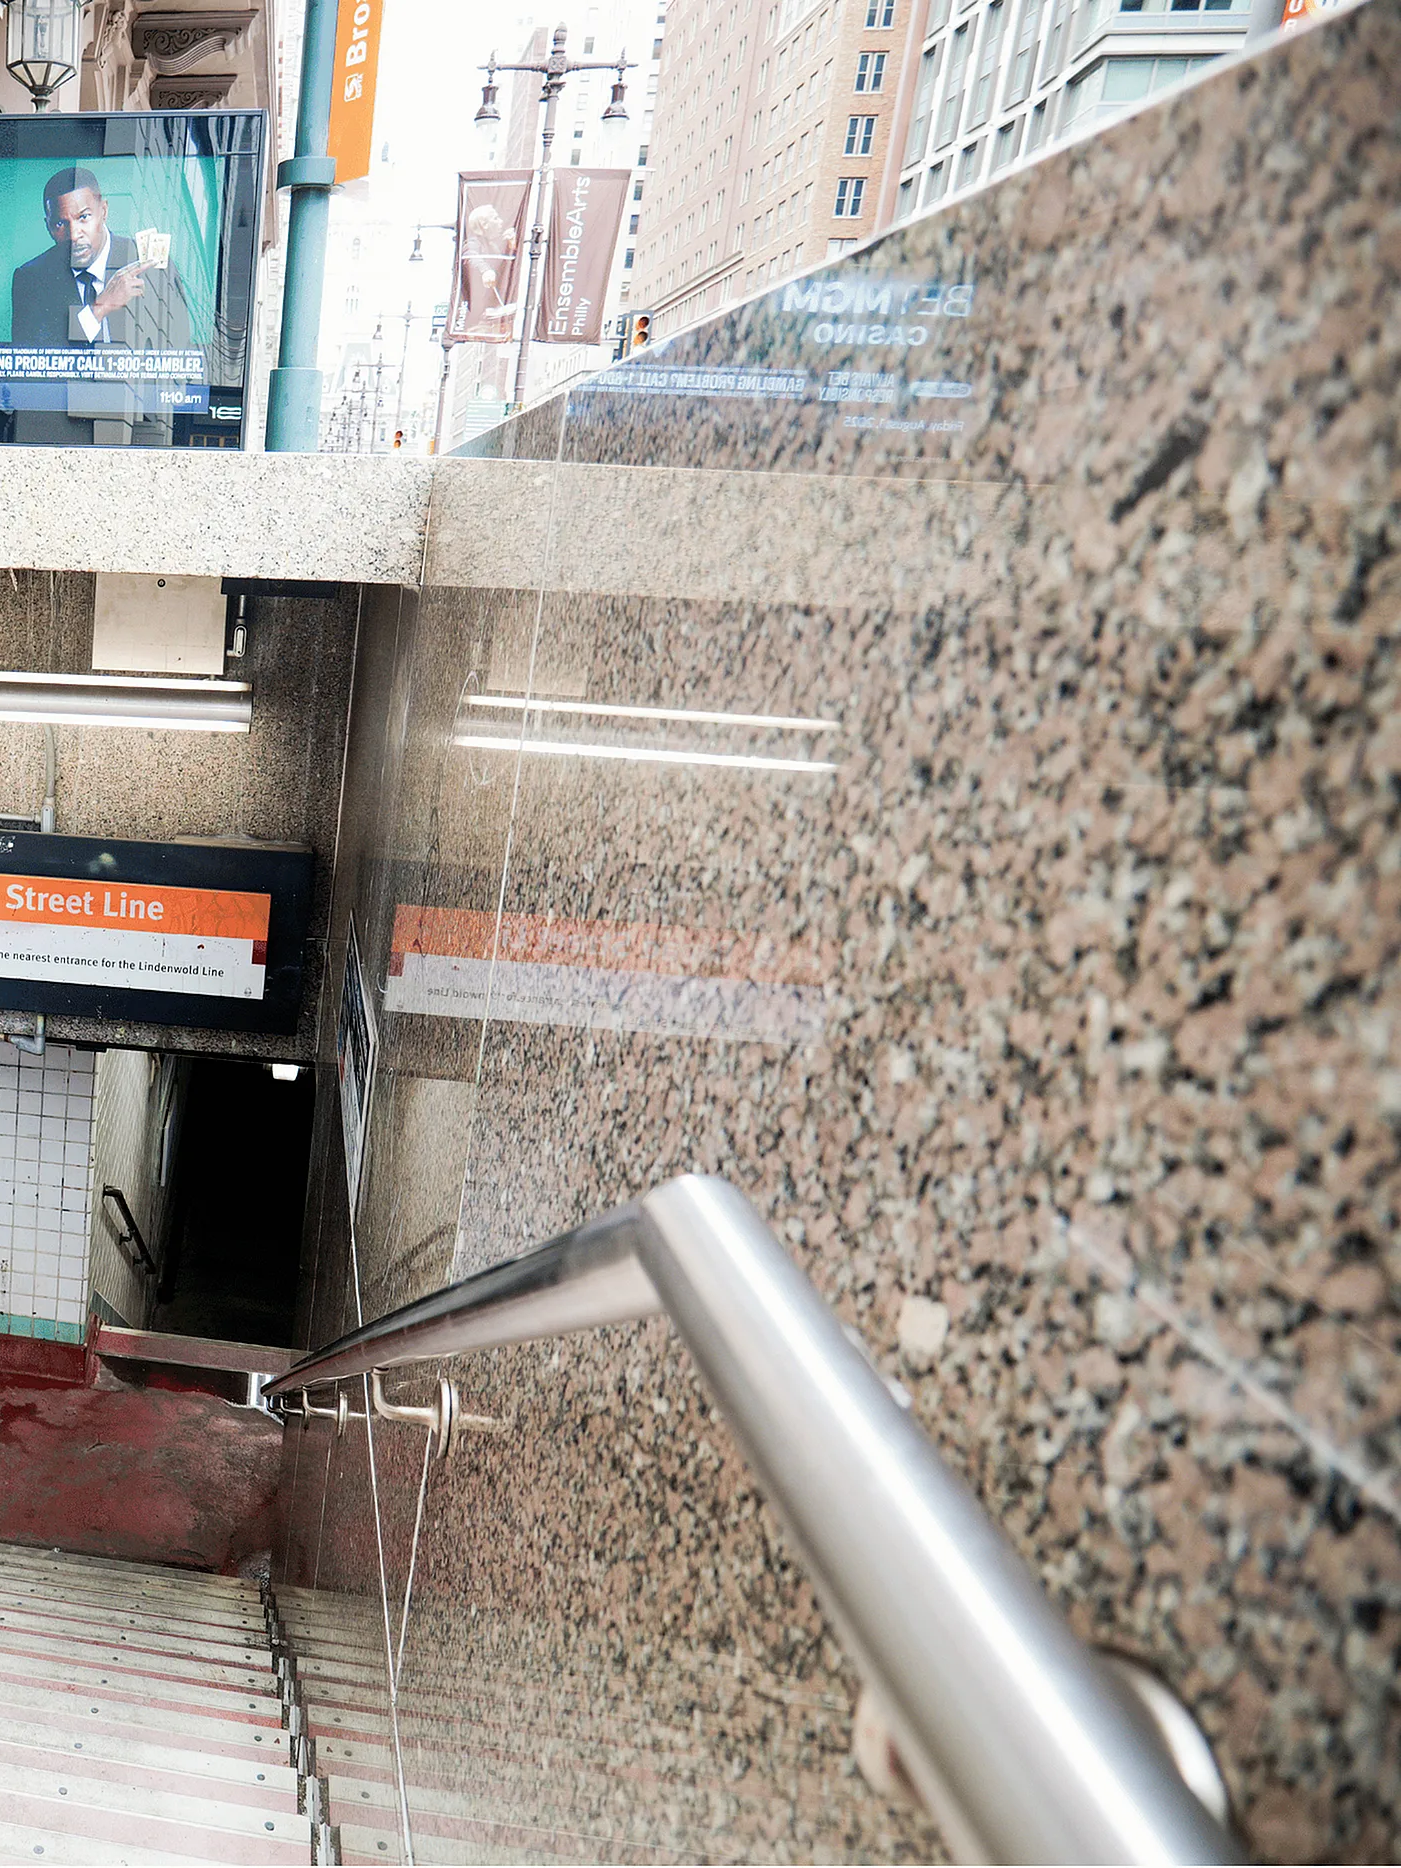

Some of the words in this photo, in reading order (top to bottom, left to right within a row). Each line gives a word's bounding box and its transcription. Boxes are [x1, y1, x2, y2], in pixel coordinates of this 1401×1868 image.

[549, 175, 590, 336] EnsembleArts
[455, 300, 469, 331] Music
[571, 296, 589, 336] Philly
[15, 355, 75, 371] PROBLEM?
[77, 356, 105, 371] CALL
[107, 357, 204, 372] 1-800-GAMBLER.
[185, 395, 202, 404] am
[6, 883, 95, 916] Street
[103, 891, 165, 921] Line
[12, 951, 52, 965] nearest
[54, 956, 98, 968] entrance
[101, 956, 116, 970] for
[118, 958, 135, 971] the
[138, 959, 199, 976] Lindenwold
[202, 965, 225, 978] Line
